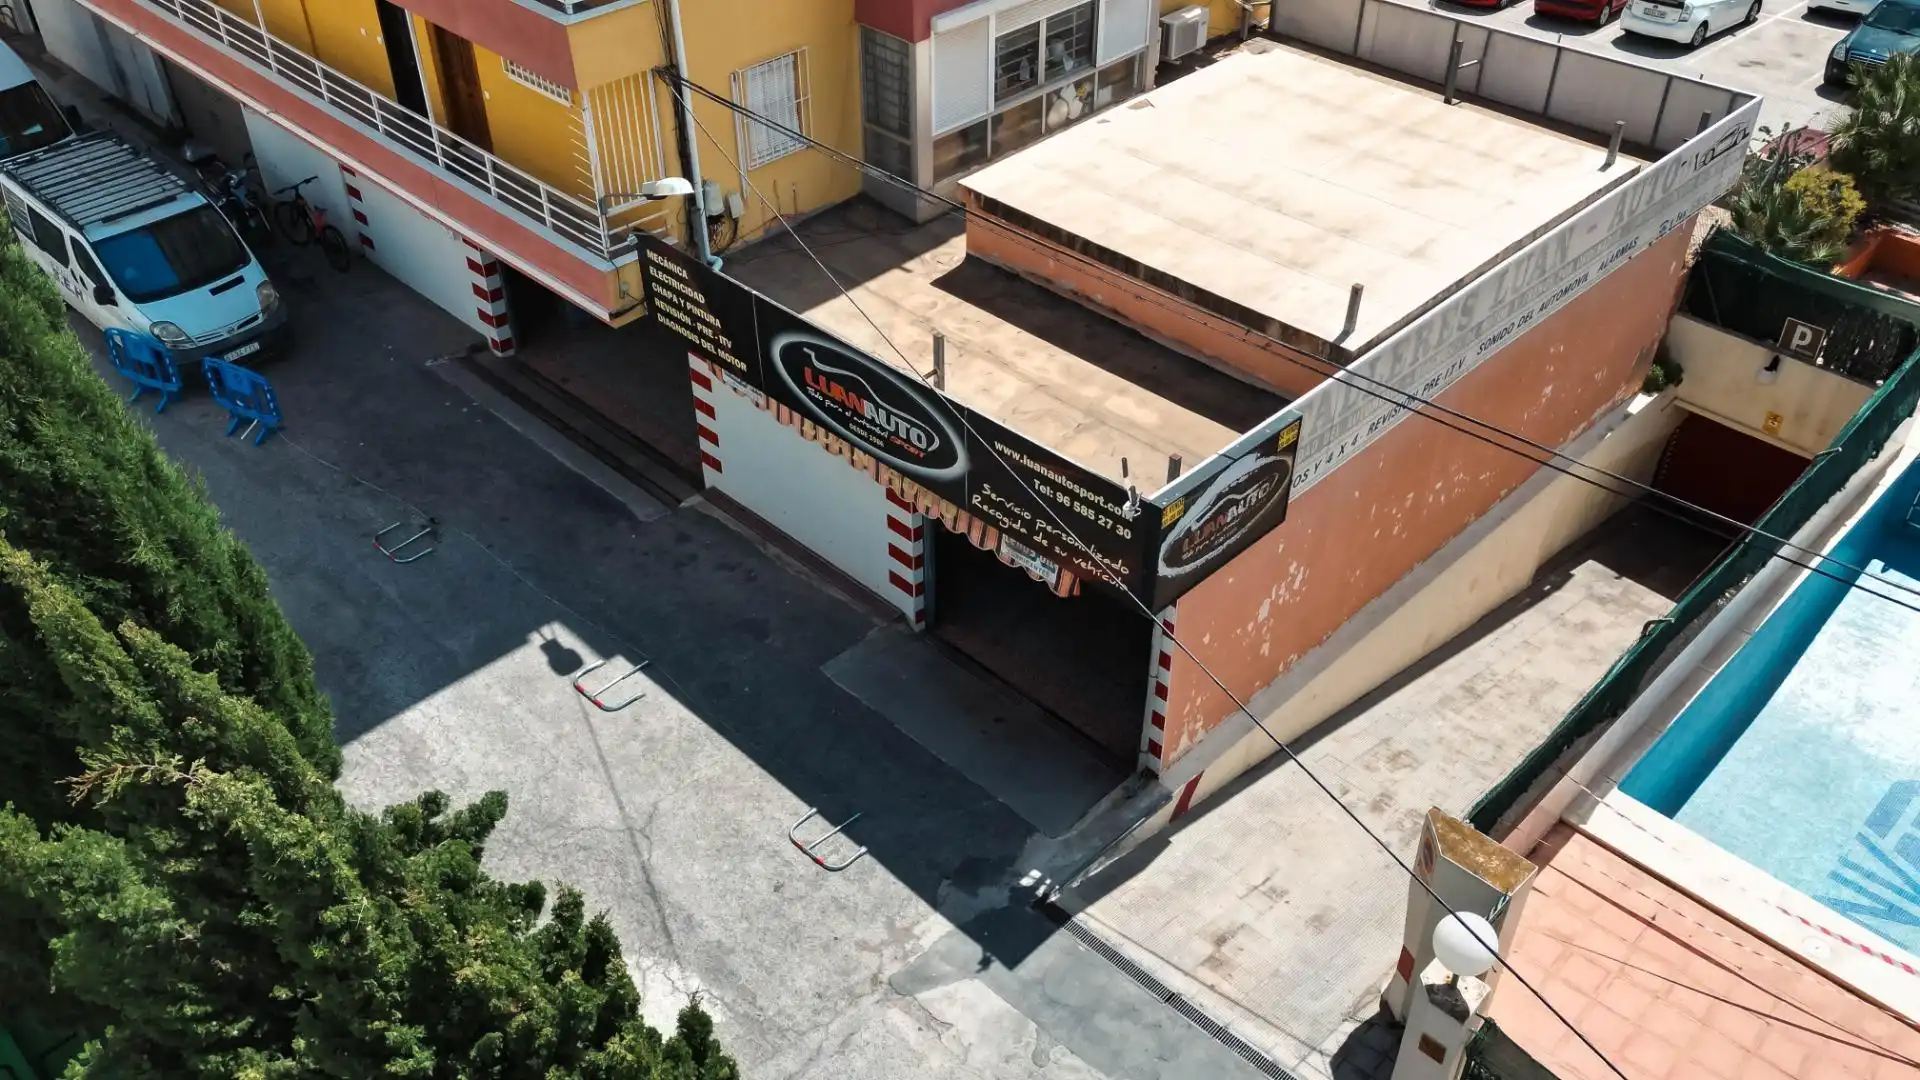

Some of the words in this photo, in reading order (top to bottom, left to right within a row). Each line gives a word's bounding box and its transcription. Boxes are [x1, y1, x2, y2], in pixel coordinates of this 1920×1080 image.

[646, 249, 688, 280] MECÁNICA
[649, 265, 705, 304] ELECTRICIDAD
[652, 282, 678, 304] CHAPA
[680, 298, 685, 308] Y
[686, 302, 721, 329] PINTURA
[654, 297, 692, 326] REVISIÓN
[697, 322, 714, 339] PRE
[719, 335, 732, 348] ITV
[657, 312, 700, 344] DIAGNOSIS
[701, 338, 716, 354] DEL
[718, 348, 747, 372] MOTOR
[1789, 323, 1813, 351] P
[972, 494, 1028, 535] Recogida
[1033, 532, 1049, 547] de
[982, 483, 1032, 520] Servicio
[1033, 478, 1054, 498] Tel:
[1056, 491, 1071, 507] 96
[1073, 502, 1095, 521] 585
[1097, 514, 1113, 530] 27
[1116, 524, 1132, 540] 30
